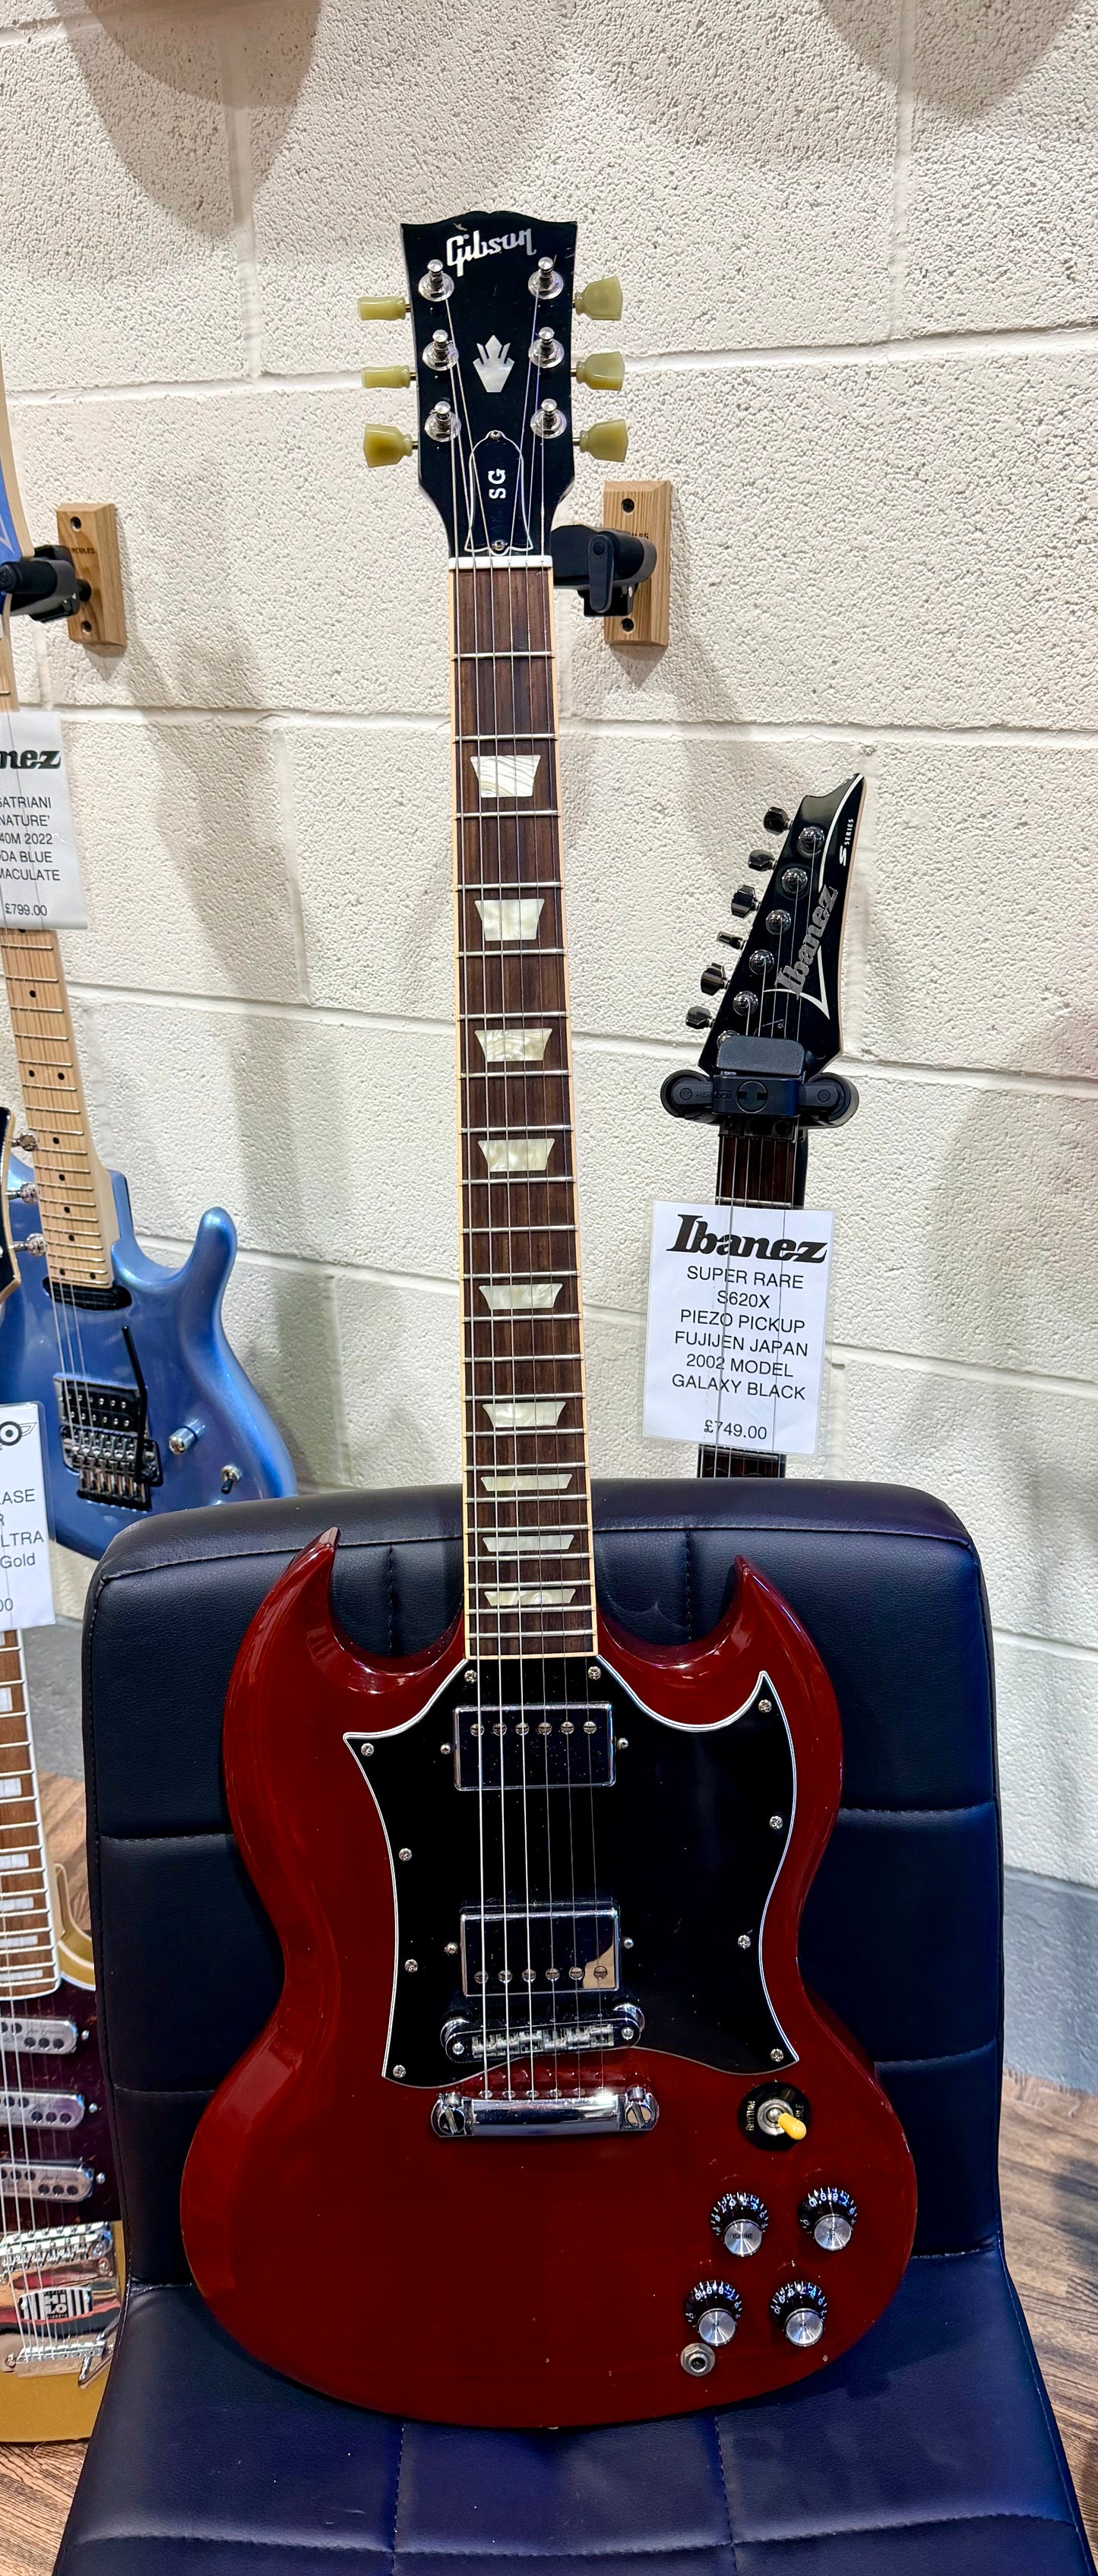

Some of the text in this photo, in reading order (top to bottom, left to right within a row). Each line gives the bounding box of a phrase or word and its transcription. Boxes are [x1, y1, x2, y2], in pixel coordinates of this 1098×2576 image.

[446, 228, 537, 277] Gibson
[487, 468, 506, 500] SG
[24, 833, 53, 845] 2022
[844, 818, 854, 845] SERIES
[20, 851, 52, 864] BLUE
[5, 903, 48, 917] £799.00
[774, 884, 839, 1001] Ibanez
[666, 1214, 828, 1264] Ibanez
[687, 1266, 805, 1289] SUPER RARE
[717, 1290, 770, 1309] S620X
[680, 1309, 805, 1334] PIEZO PICKUP
[675, 1331, 808, 1357] FUJIJEN JAPAN
[686, 1353, 794, 1377] 2002 MODEL
[672, 1374, 805, 1400] GALAXY BLACK
[704, 1419, 767, 1440] £749.00
[0, 1552, 36, 1569] Gold
